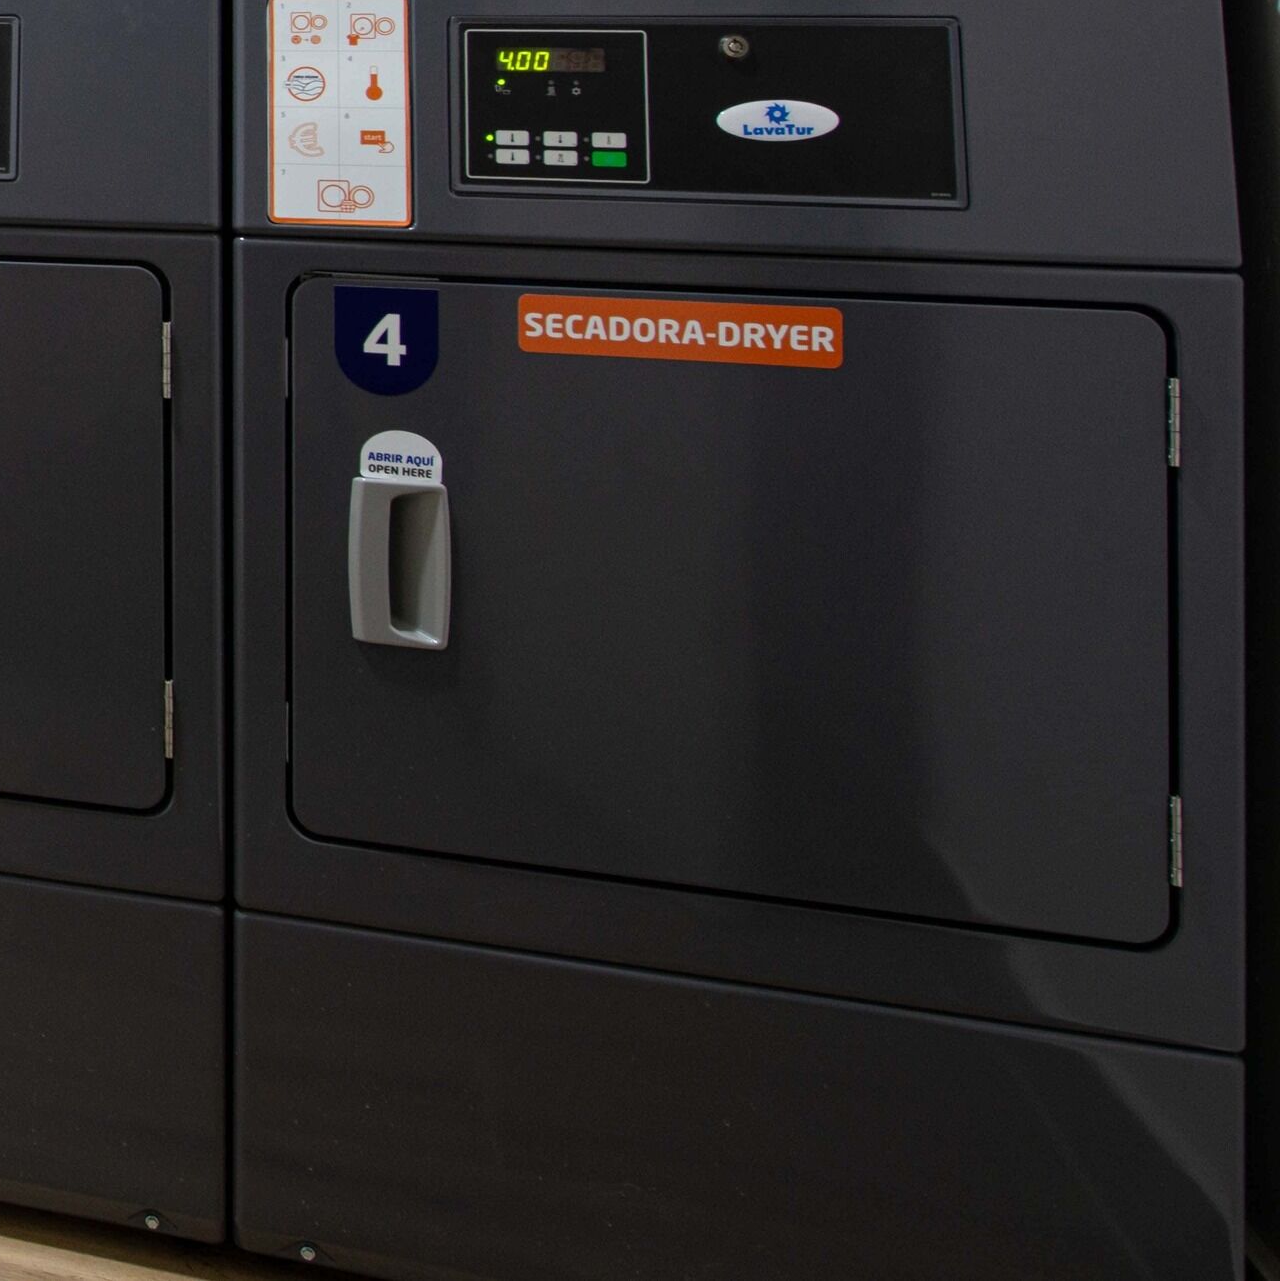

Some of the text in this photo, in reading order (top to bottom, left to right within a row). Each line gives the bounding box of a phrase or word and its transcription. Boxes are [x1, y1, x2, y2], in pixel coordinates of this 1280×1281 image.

[498, 50, 550, 71] 4.00
[743, 124, 814, 137] LavaTur
[362, 313, 408, 366] 4
[524, 311, 836, 353] SECADORA-DRYER
[368, 451, 434, 467] ABRIR AQUÍ
[368, 464, 432, 479] OPEN HERE
